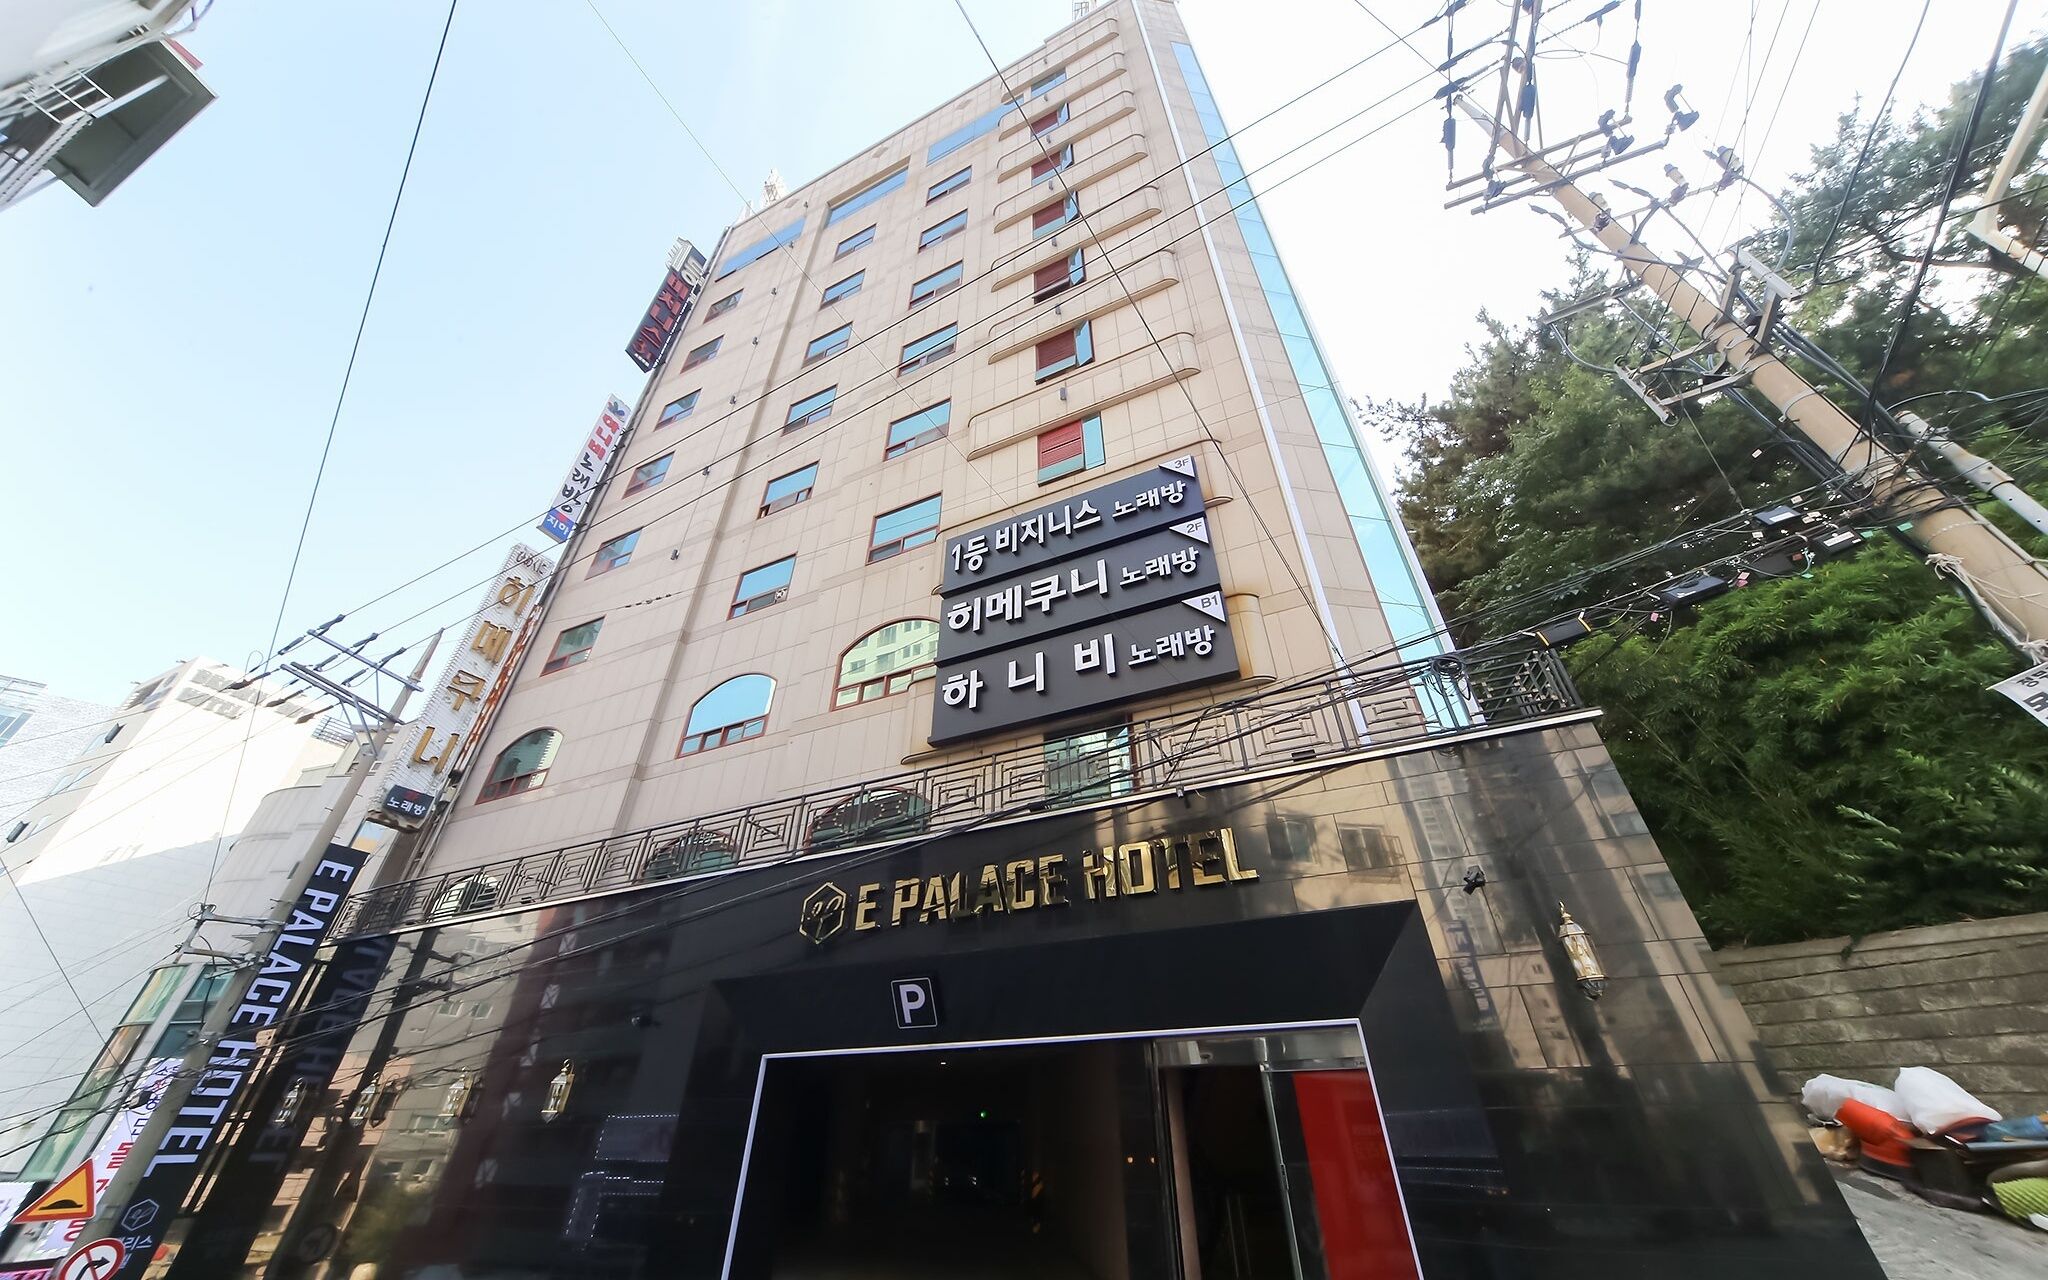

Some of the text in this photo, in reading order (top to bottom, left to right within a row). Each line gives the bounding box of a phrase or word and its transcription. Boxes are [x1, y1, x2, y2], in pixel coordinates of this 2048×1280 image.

[561, 452, 595, 515] 노래방
[1174, 455, 1189, 469] 3F
[951, 480, 1186, 571] 1등 비지니스 노래방
[1186, 521, 1203, 534] 2F
[948, 547, 1198, 632] 히메쿠니 노래방
[1201, 595, 1218, 608] B1
[1128, 625, 1215, 667] 노래방
[412, 576, 536, 775] 히메쿠니
[387, 797, 426, 816] 노래방
[315, 859, 354, 883] E
[854, 827, 1259, 931] E PALACE HOTEL
[231, 888, 336, 1027] PALACE
[899, 984, 926, 1024] P
[143, 1040, 257, 1178] HOTEL
